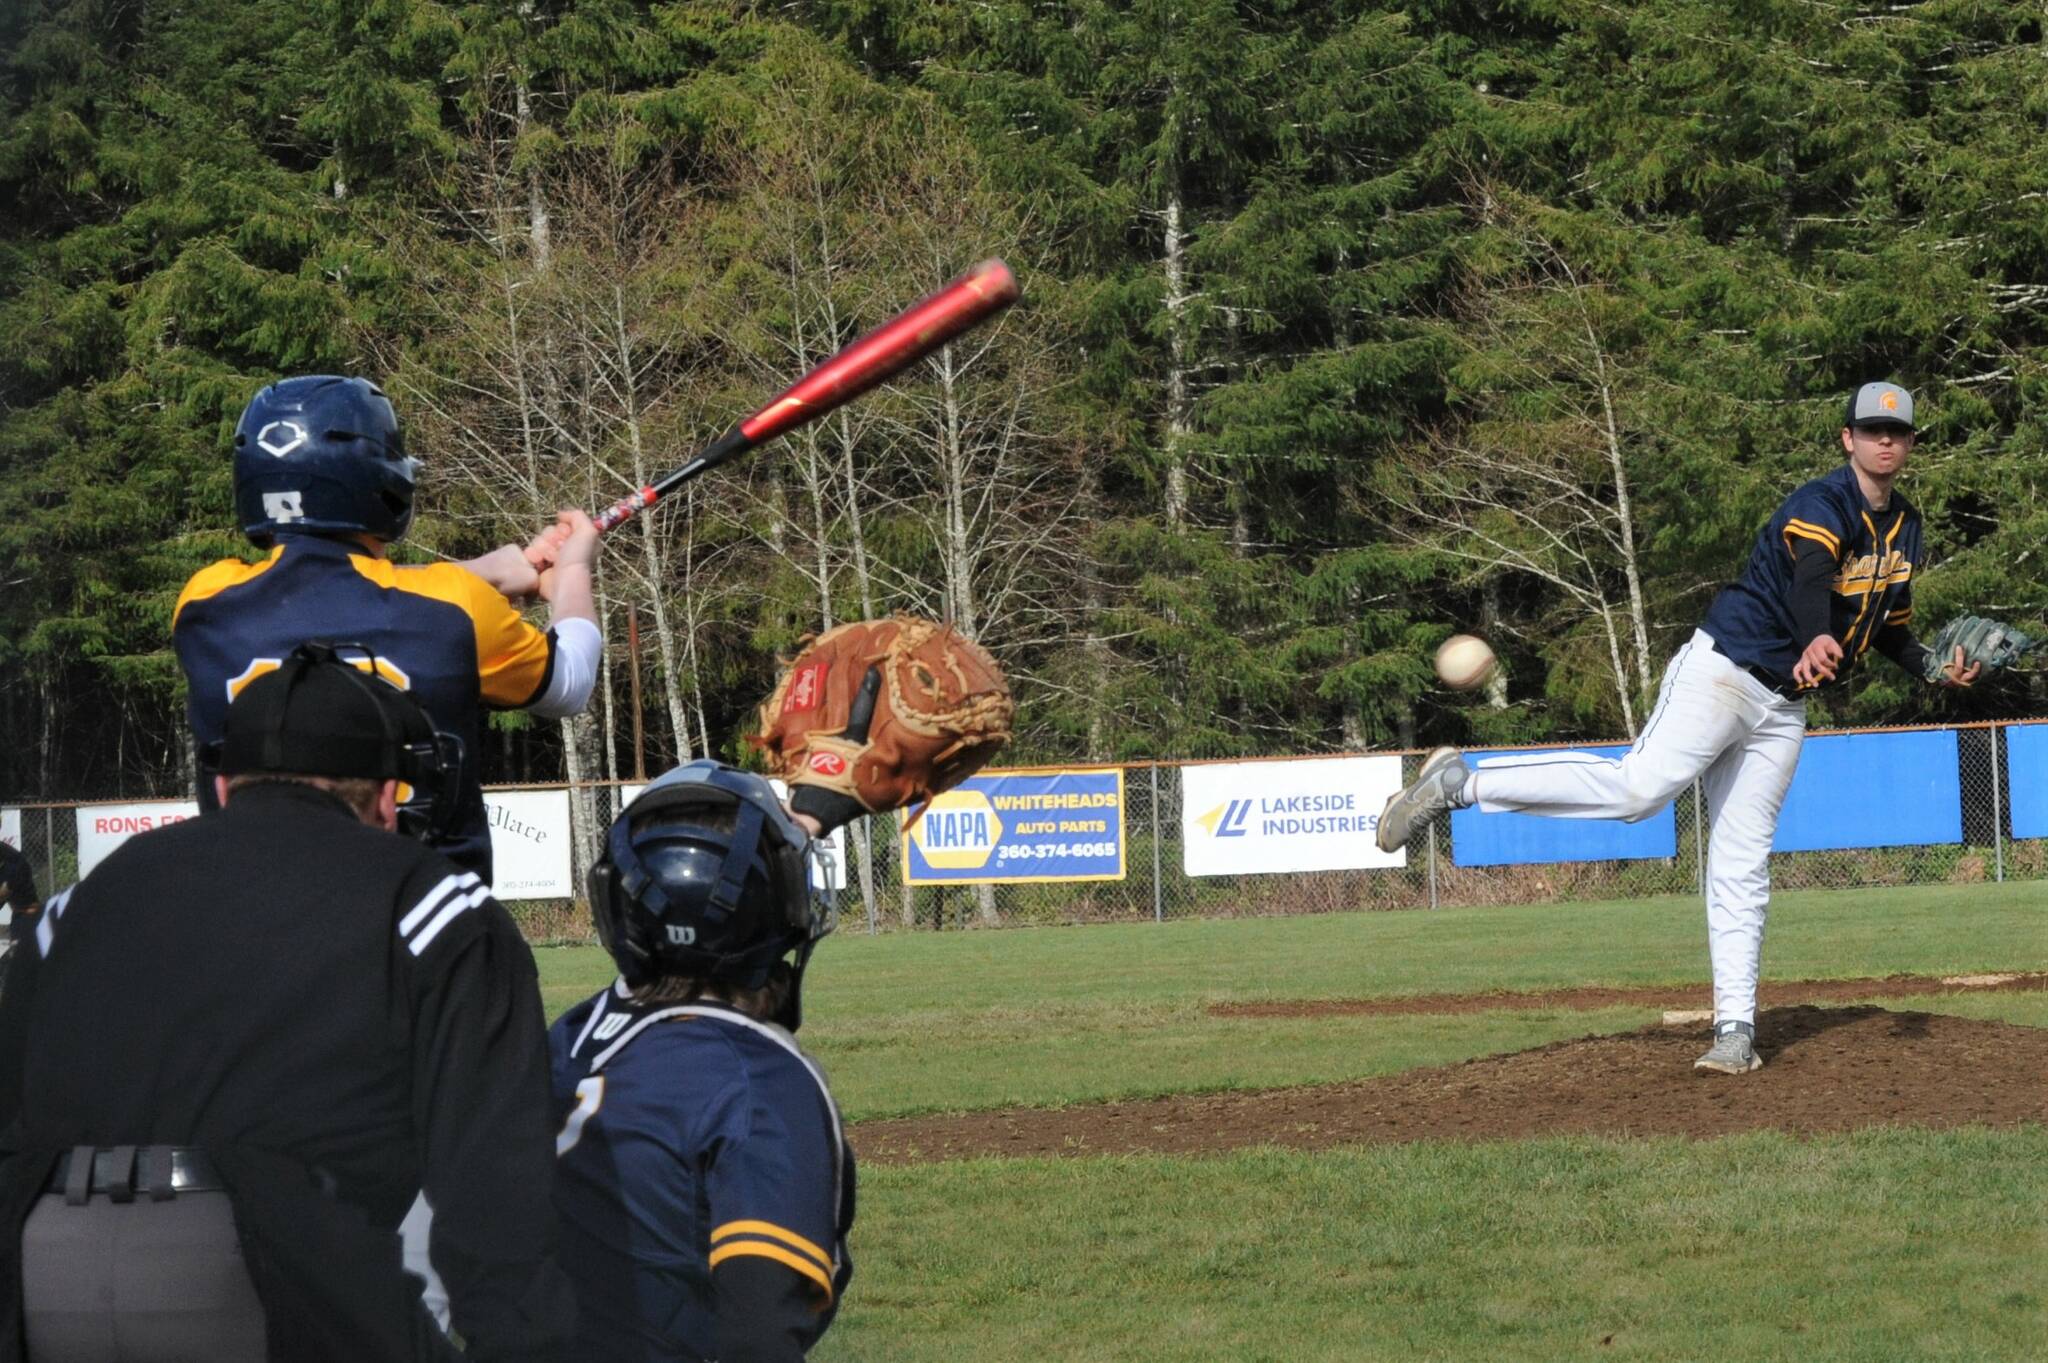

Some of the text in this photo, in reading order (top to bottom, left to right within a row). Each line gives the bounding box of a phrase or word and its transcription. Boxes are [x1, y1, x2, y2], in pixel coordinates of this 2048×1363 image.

[992, 792, 1118, 811] WHITEHEADS
[1261, 794, 1355, 814] LAKESIDE
[95, 816, 153, 834] RONS
[926, 812, 989, 848] NAPA
[1015, 820, 1107, 835] AUTO PARTS
[1262, 815, 1378, 836] INDUSTRIES
[998, 842, 1117, 860] 360-374-6065
